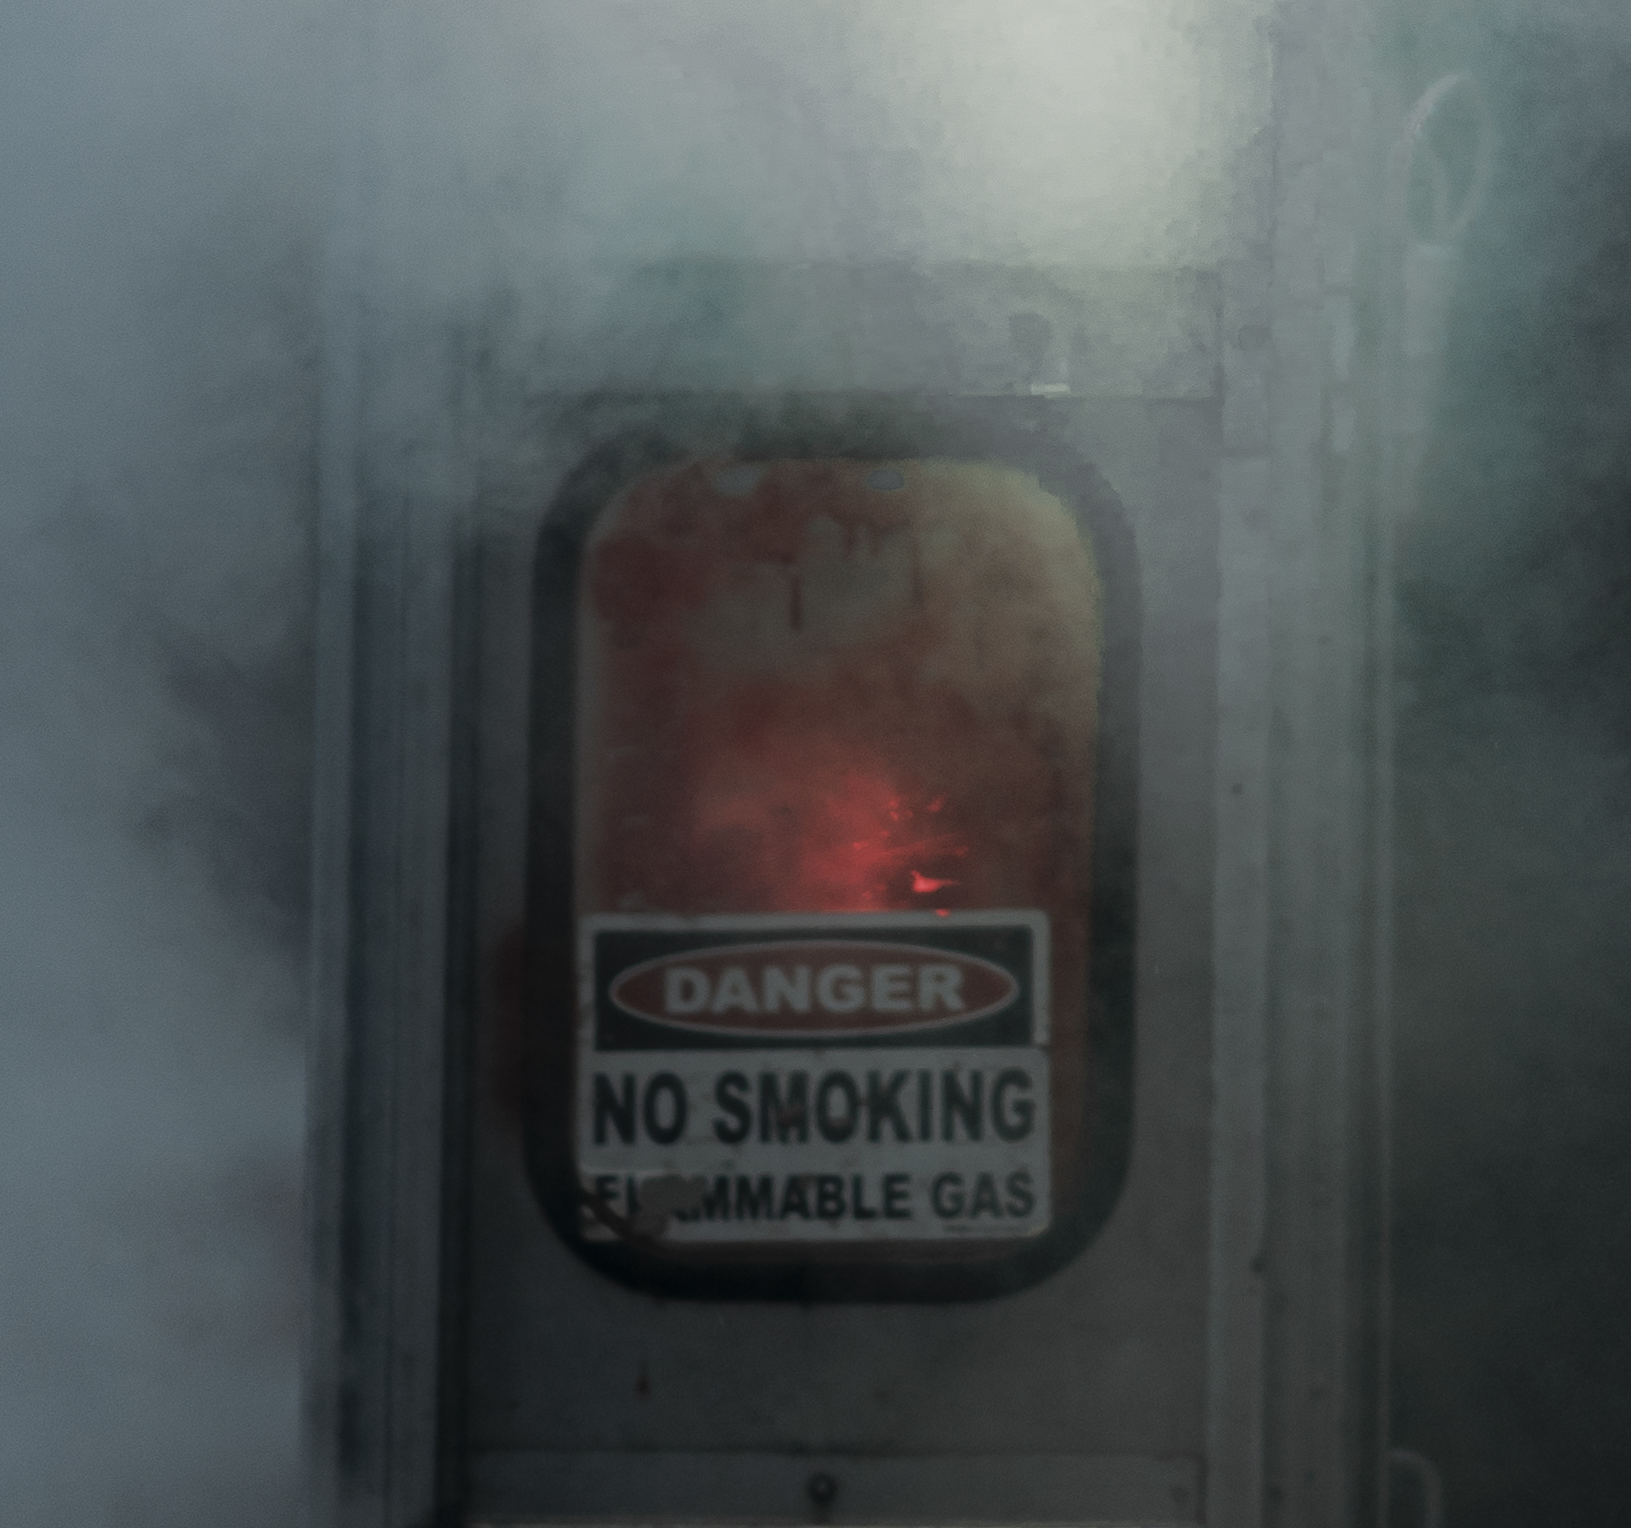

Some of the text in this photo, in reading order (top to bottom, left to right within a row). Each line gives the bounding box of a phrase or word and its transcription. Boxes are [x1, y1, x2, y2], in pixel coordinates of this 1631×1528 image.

[663, 963, 967, 1016] DANGER
[594, 1070, 1037, 1144] NO SMOKING
[594, 1172, 1037, 1221] FLMMABLE GAS
